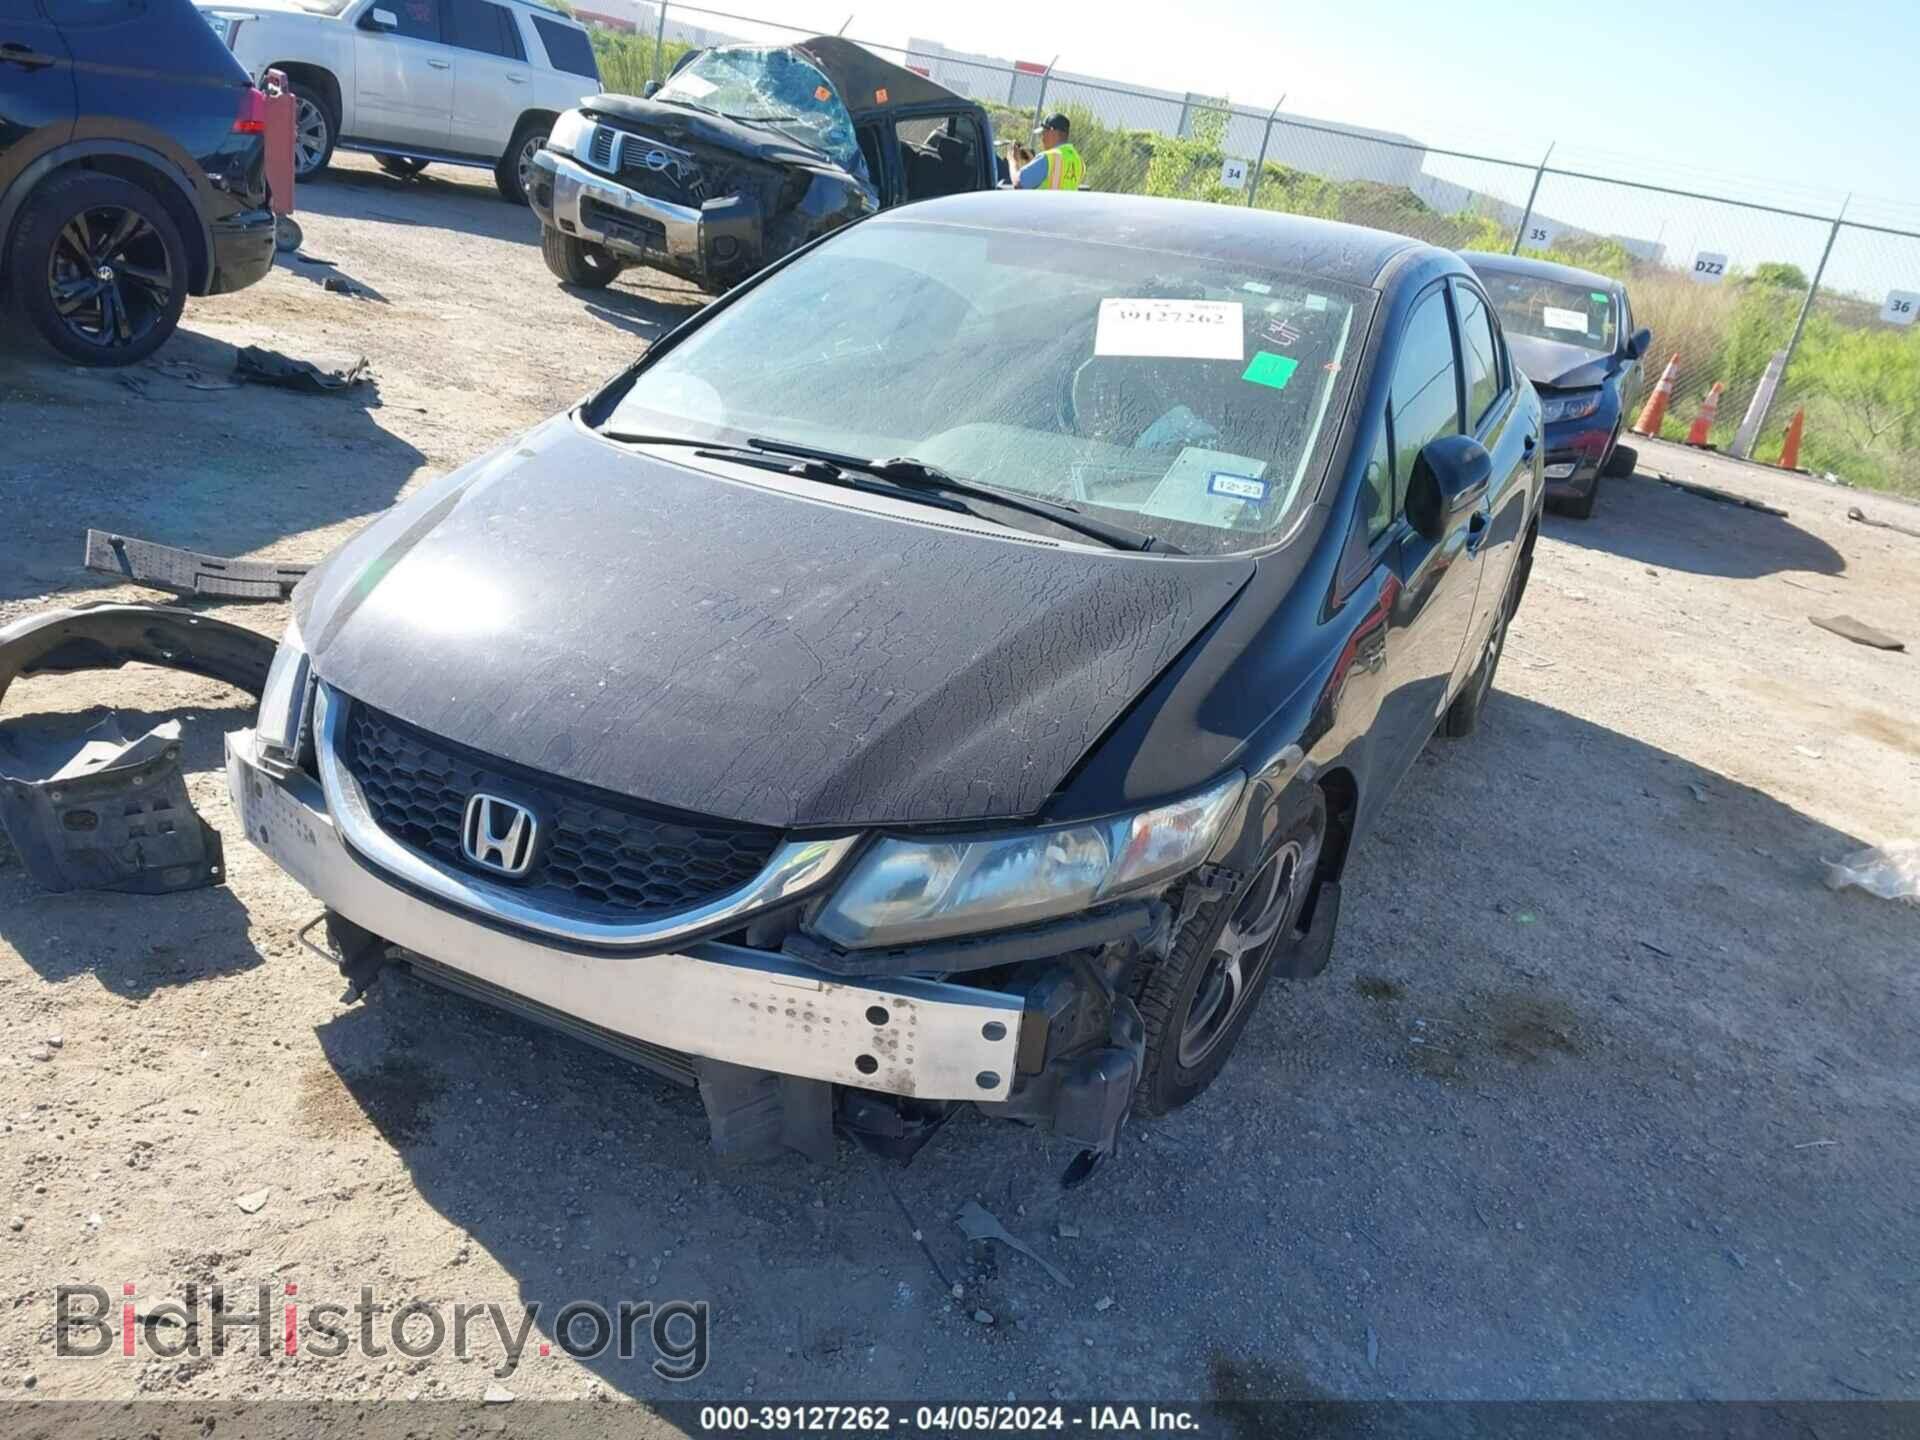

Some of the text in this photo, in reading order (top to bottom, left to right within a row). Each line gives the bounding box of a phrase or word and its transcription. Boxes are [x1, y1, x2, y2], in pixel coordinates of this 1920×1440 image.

[1226, 167, 1242, 180] 34
[1530, 228, 1547, 242] 35
[1694, 259, 1725, 276] DZ2
[1890, 298, 1911, 314] 36
